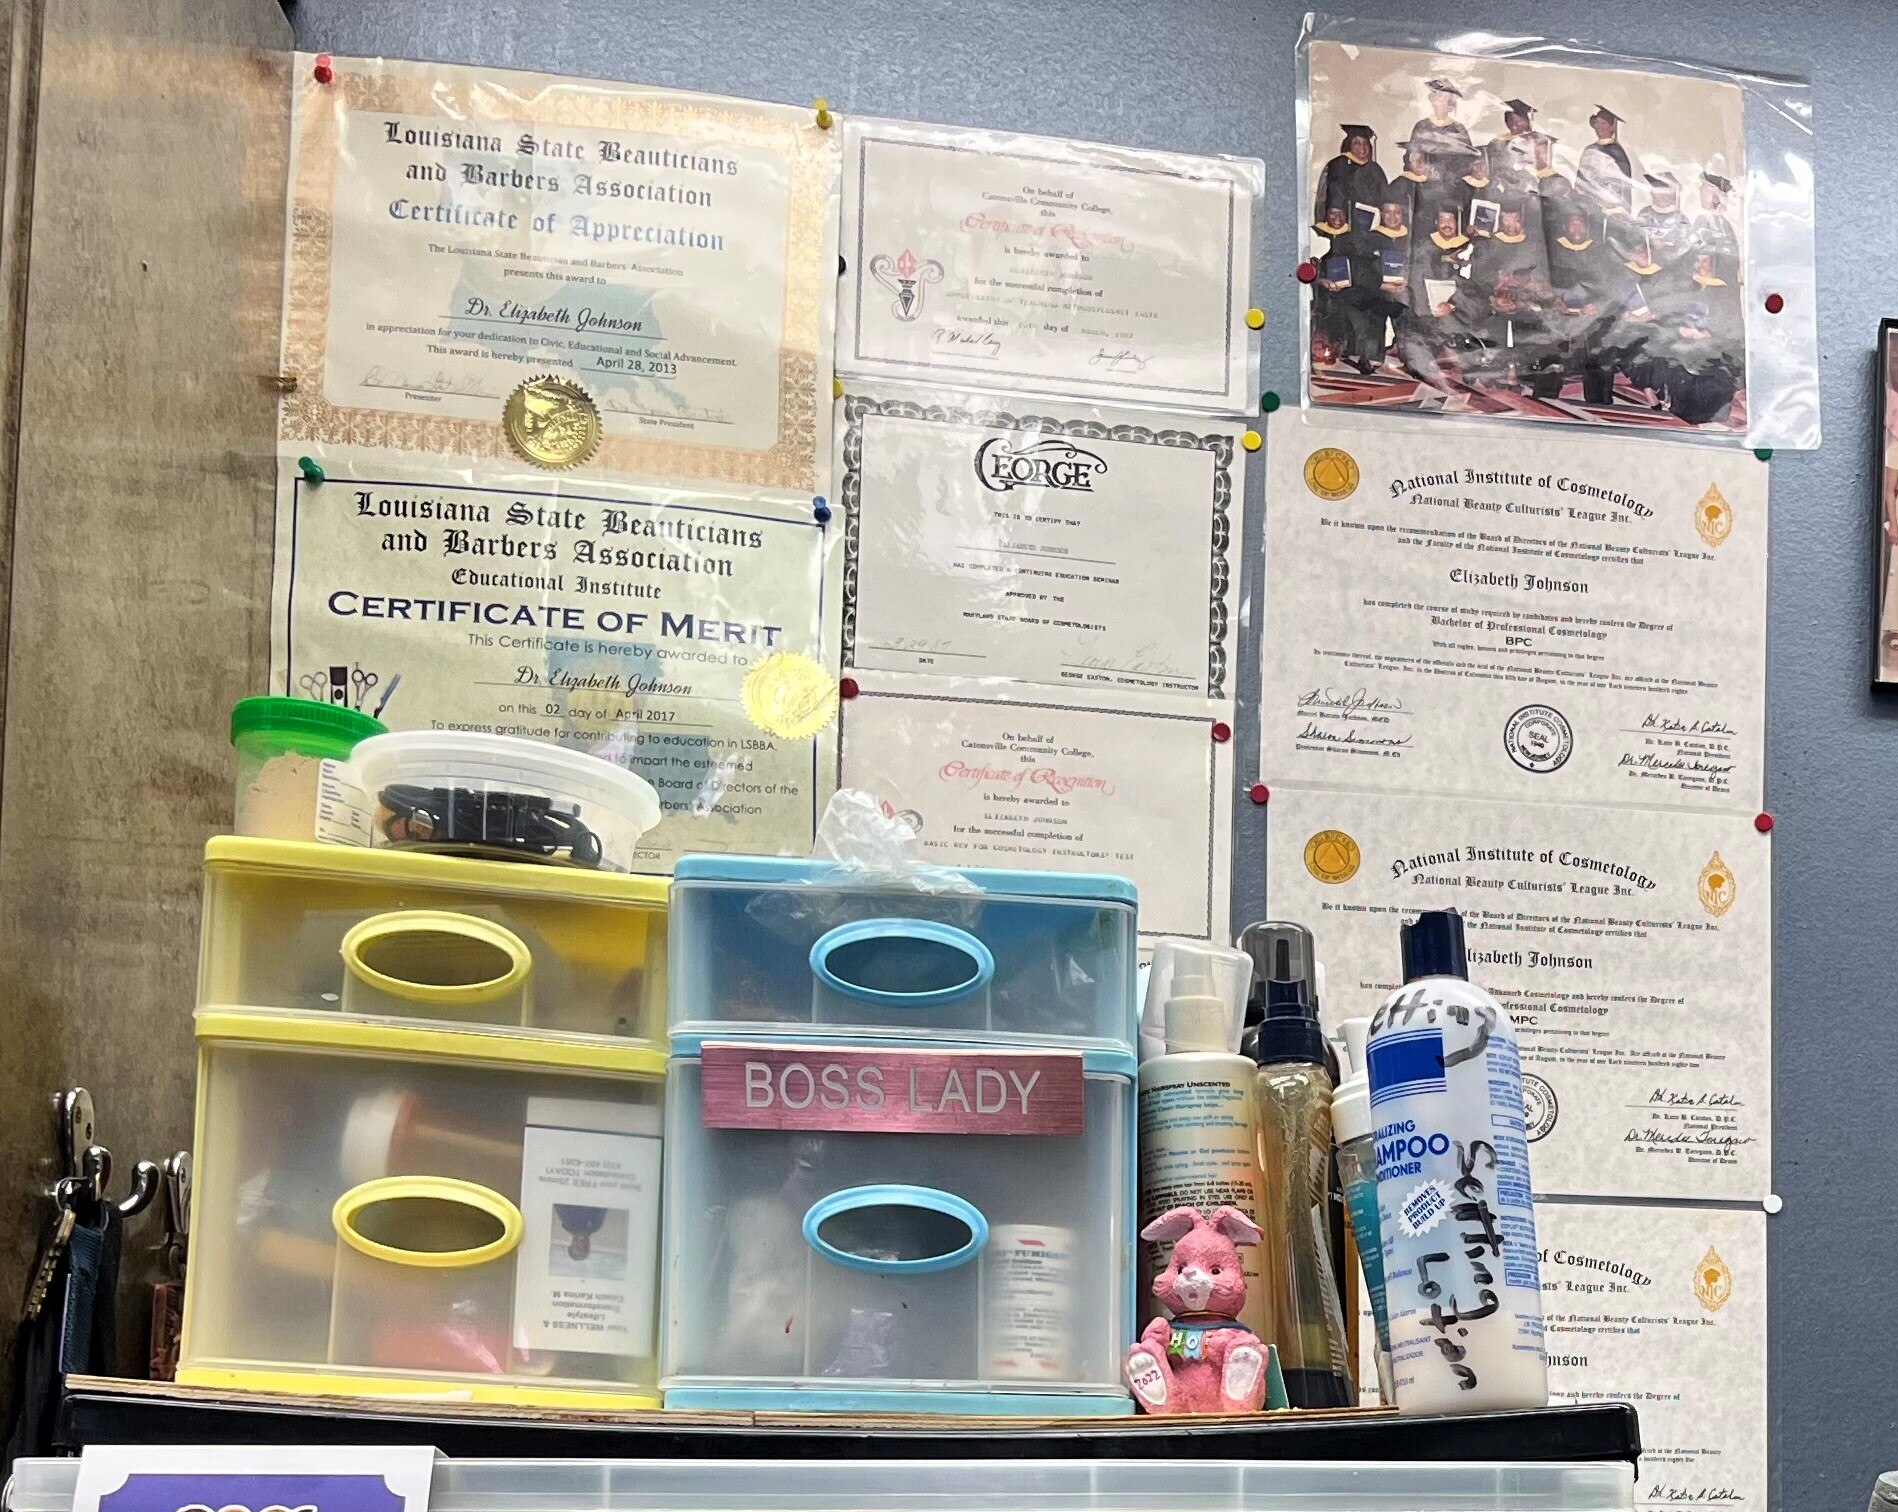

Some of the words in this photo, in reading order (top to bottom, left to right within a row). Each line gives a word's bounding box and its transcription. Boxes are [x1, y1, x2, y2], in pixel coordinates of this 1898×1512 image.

[384, 121, 501, 153] Louisiana
[516, 133, 585, 160] State
[599, 140, 739, 176] Beauticians
[406, 162, 447, 182] and
[460, 162, 559, 193] Barbers
[573, 173, 712, 208] Association
[389, 199, 517, 230] Certificate
[533, 214, 556, 233] of
[569, 216, 724, 251] Appreciation
[500, 301, 570, 326] Elizabeth
[576, 308, 642, 333] Johnson
[596, 356, 624, 371] April
[627, 359, 646, 372] 28,
[650, 362, 677, 375] 2013
[1388, 469, 1460, 500] National
[1464, 468, 1533, 487] Institute
[1538, 472, 1552, 489] of
[1557, 477, 1655, 520] Cosmetology
[1409, 494, 1460, 509] National
[1463, 496, 1502, 513] Beauty
[1567, 506, 1606, 523] League
[1609, 509, 1632, 524] Inc.
[354, 490, 490, 523] Louisiana
[506, 501, 586, 530] State
[601, 508, 763, 549] Beauticians
[382, 530, 427, 552] and
[443, 529, 557, 562] Barbers
[573, 539, 734, 578] Association
[452, 570, 564, 592] Educational
[575, 576, 662, 600] Institute
[1449, 569, 1519, 591] Elizabeth
[1524, 573, 1589, 595] Johnson
[328, 590, 585, 629] CERTIFICATE
[597, 610, 647, 633] OF
[662, 613, 782, 647] MERIT
[467, 633, 494, 647] This
[499, 635, 579, 652] Certificate
[584, 641, 593, 653] is
[598, 642, 653, 660] hereby
[657, 647, 727, 664] awarded
[732, 654, 747, 665] to
[1505, 636, 1532, 647] BPC
[514, 666, 540, 685] Dr
[548, 670, 621, 692] Elizabeth
[626, 675, 693, 696] Johnson
[939, 761, 1011, 787] Certificate
[1014, 768, 1027, 787] of
[1030, 769, 1116, 795] Recognition
[1390, 847, 1460, 880] National
[1466, 846, 1534, 864] Institute
[1539, 848, 1553, 865] of
[1558, 852, 1656, 892] Cosmetology
[1466, 946, 1522, 968] lizabeth
[1528, 950, 1593, 970] Johnson
[1509, 1014, 1539, 1026] MPC
[744, 1061, 886, 1111] BOSS
[909, 1067, 1041, 1114] LADY
[1403, 1185, 1436, 1216] REMOVES
[1408, 1192, 1442, 1223] PRODUCT
[1413, 1211, 1435, 1230] BUILD
[1432, 1199, 1445, 1214] UP
[1452, 1140, 1503, 1321] Setting
[1134, 1370, 1160, 1390] 2022
